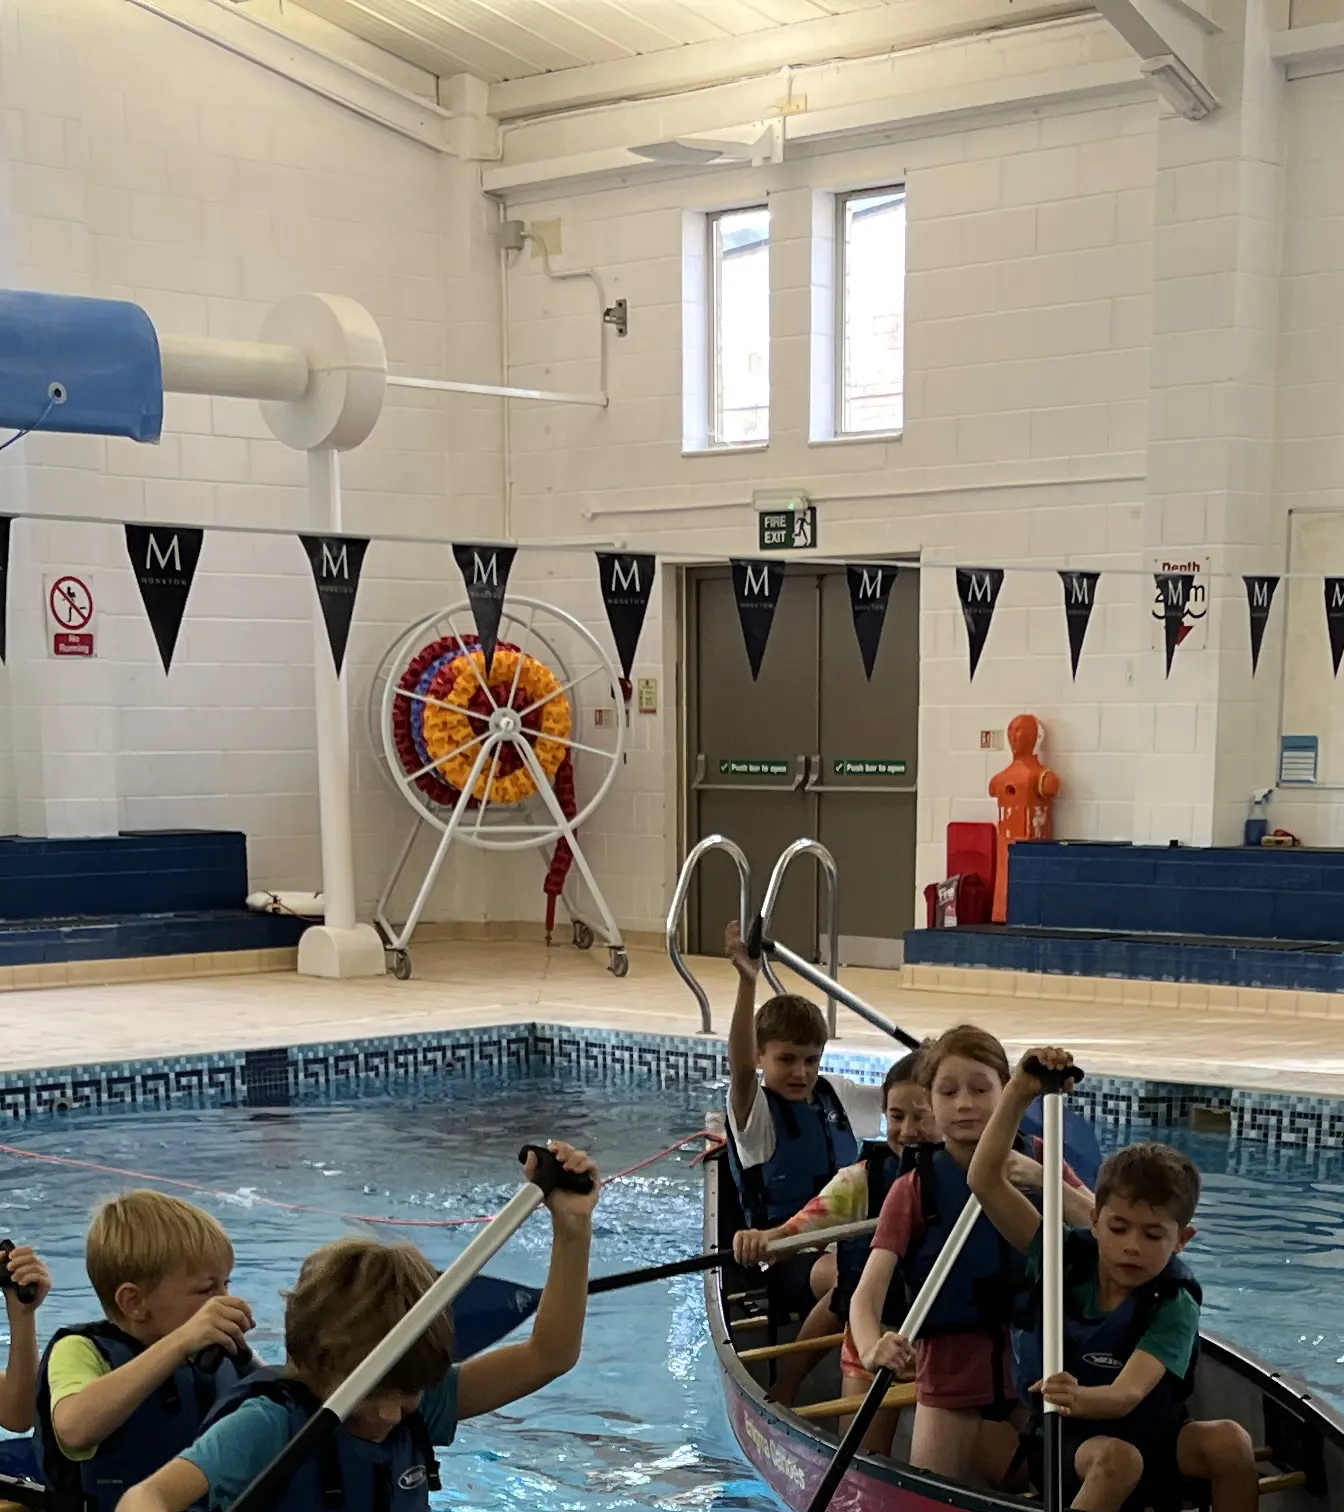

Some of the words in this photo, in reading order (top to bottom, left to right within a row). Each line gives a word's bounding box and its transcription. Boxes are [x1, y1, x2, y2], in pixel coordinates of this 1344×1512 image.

[764, 515, 787, 529] FIRE
[146, 532, 182, 571] M
[764, 530, 787, 544] EXIT
[322, 543, 349, 580] M
[473, 551, 498, 586] M
[611, 559, 641, 592] M
[744, 565, 769, 596] M
[859, 569, 883, 599] M
[967, 574, 991, 602] M
[1071, 576, 1089, 604] M
[1168, 580, 1183, 606] M
[1253, 581, 1268, 607] M
